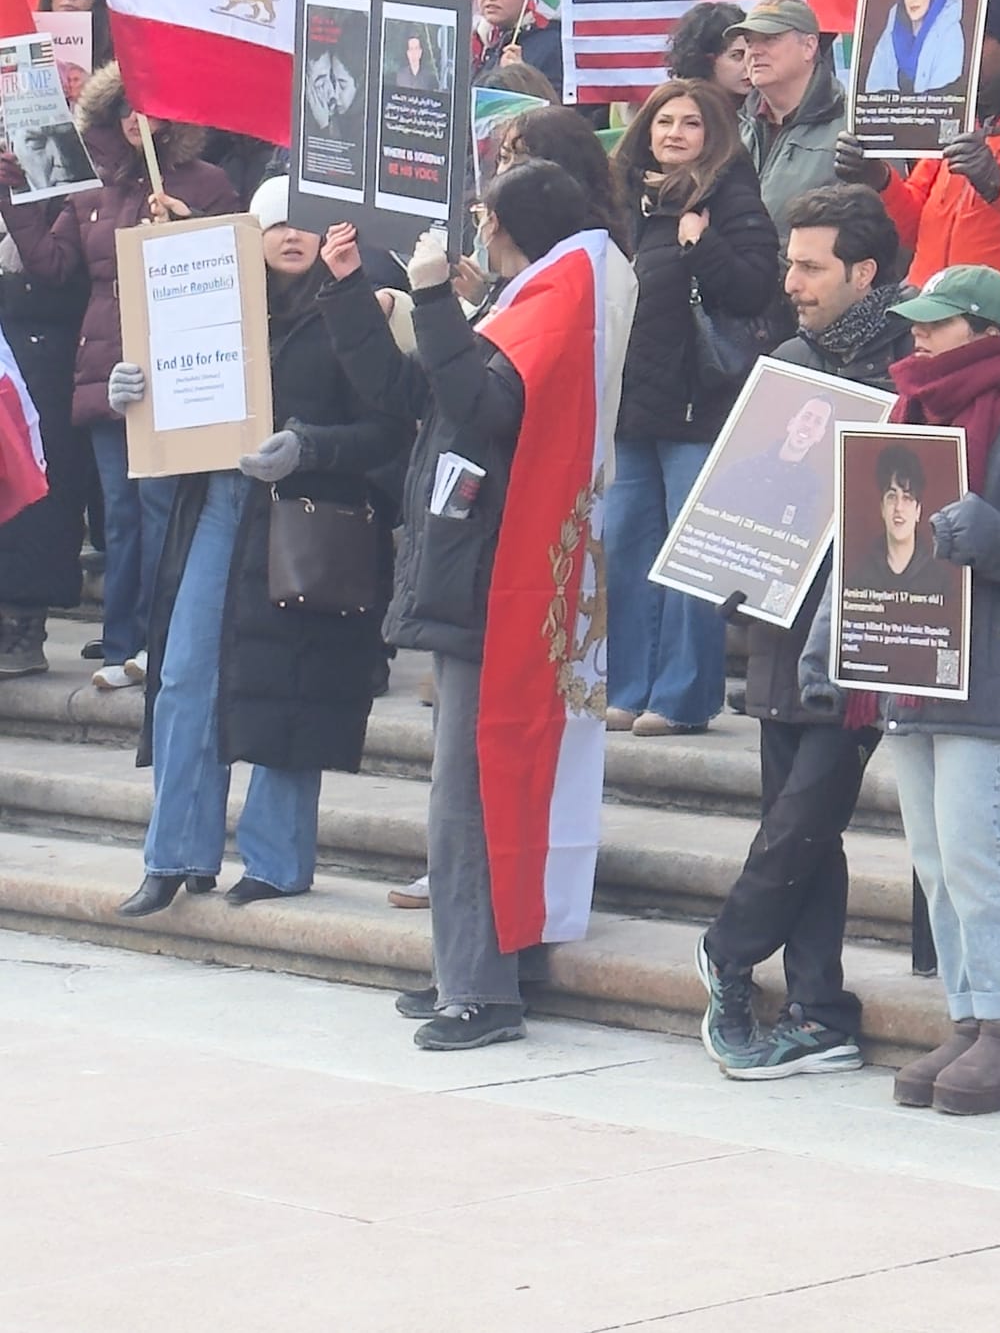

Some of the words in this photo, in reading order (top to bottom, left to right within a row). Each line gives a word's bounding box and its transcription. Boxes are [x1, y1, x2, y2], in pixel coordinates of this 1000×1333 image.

[3, 69, 51, 94] TRUMP
[170, 263, 189, 274] one
[192, 254, 235, 271] terrorist
[156, 356, 177, 371] End
[180, 354, 193, 369] 10
[195, 353, 212, 366] for
[215, 350, 239, 363] free
